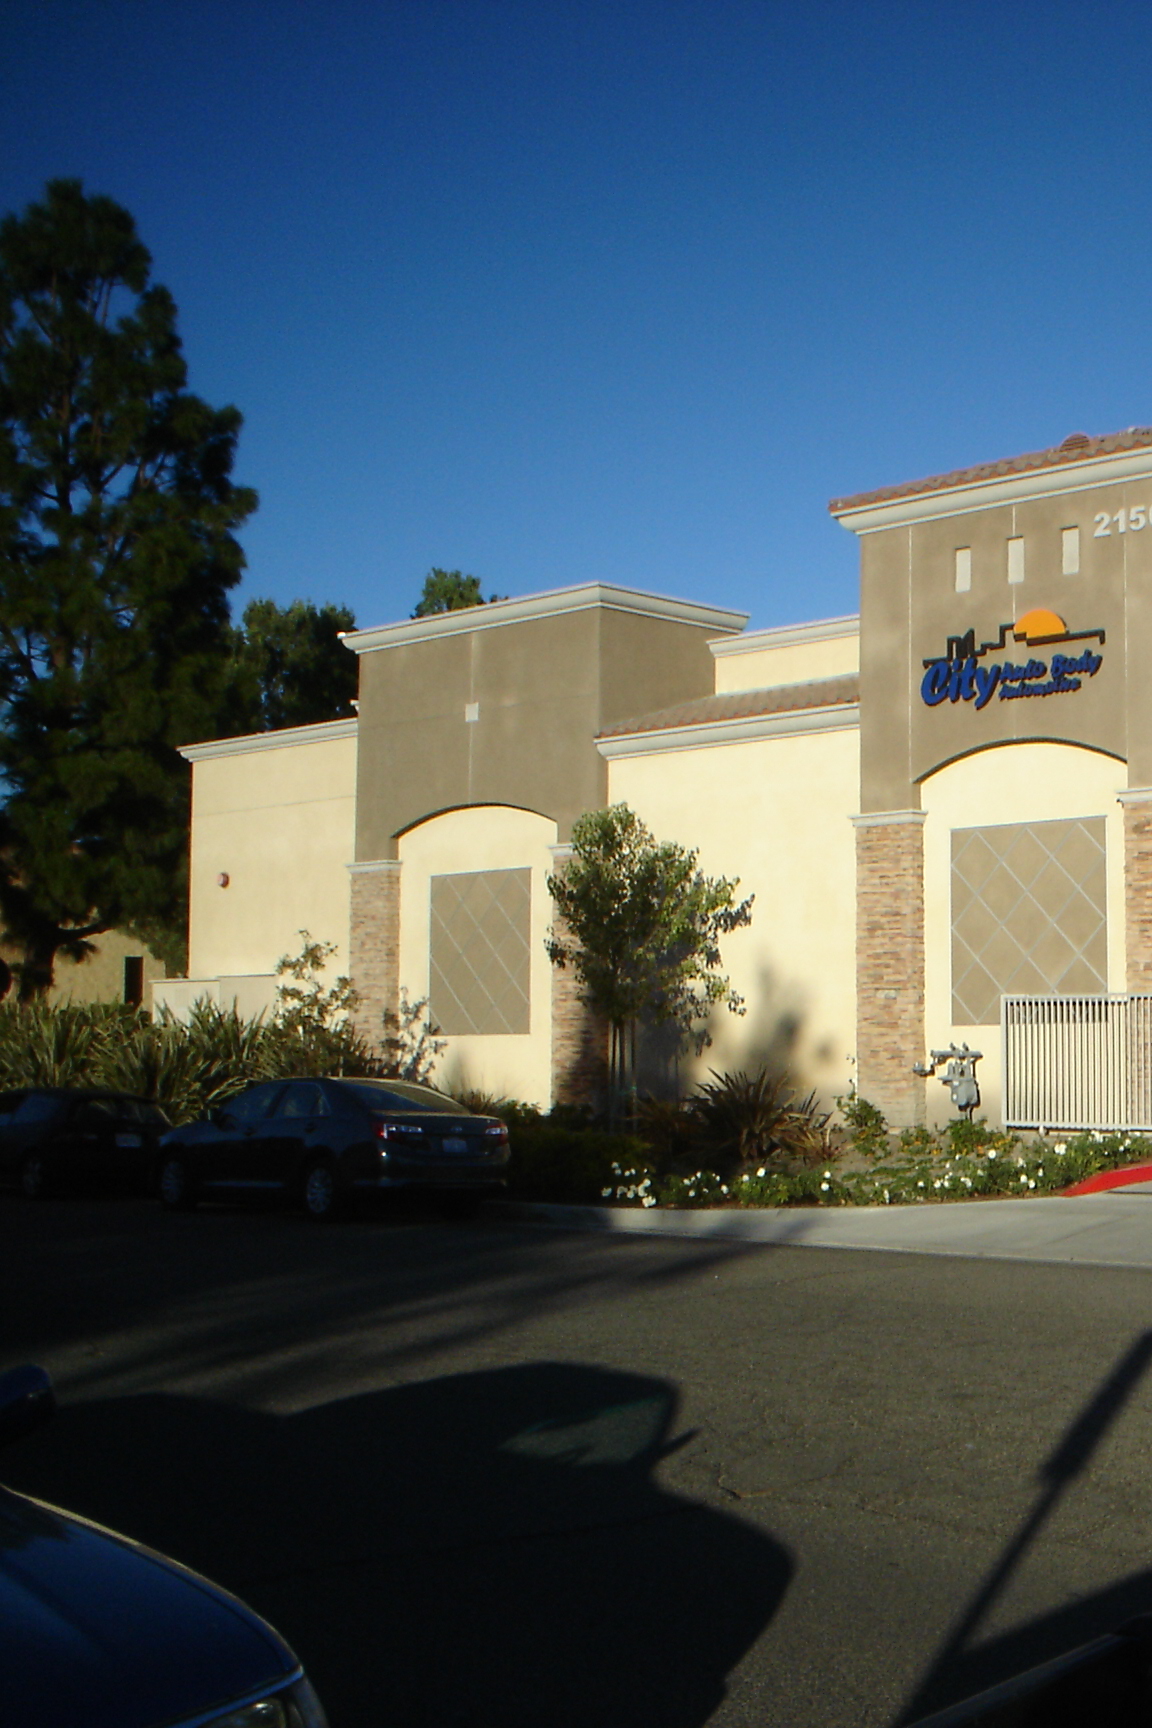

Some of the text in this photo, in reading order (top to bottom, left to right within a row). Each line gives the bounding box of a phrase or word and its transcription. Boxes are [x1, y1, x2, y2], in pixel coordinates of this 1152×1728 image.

[921, 648, 1102, 710] City Auto Body
